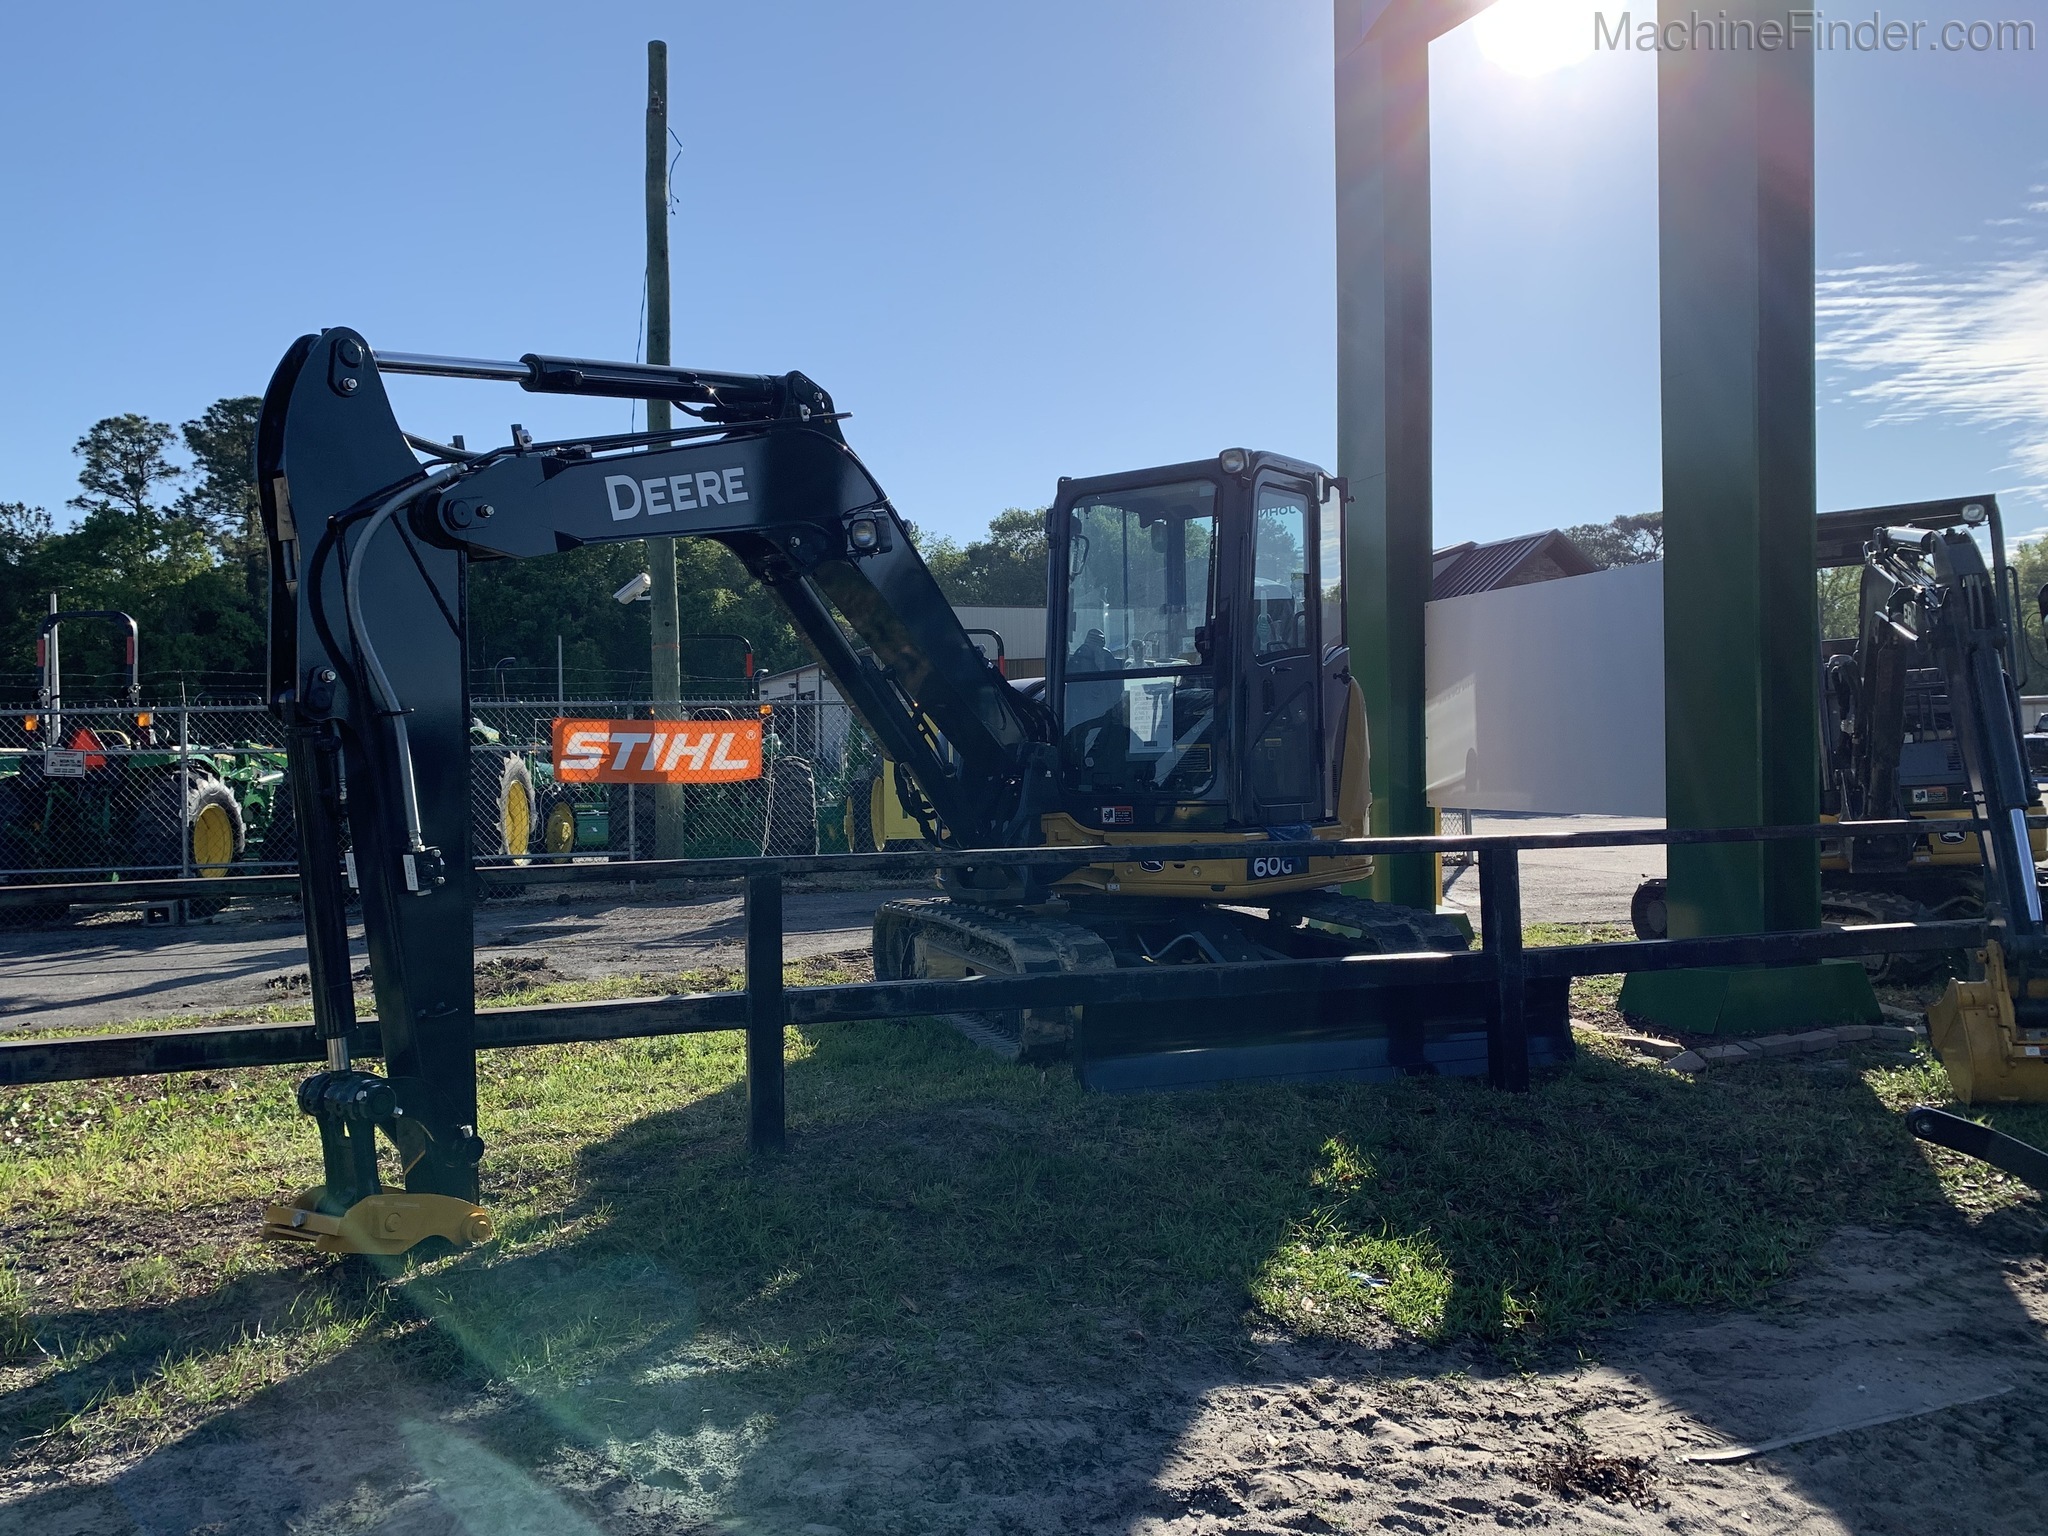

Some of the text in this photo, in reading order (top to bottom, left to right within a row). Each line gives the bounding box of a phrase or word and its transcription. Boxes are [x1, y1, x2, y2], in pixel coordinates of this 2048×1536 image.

[604, 467, 749, 521] DEERE
[559, 732, 750, 770] STIHL
[1253, 857, 1293, 878] 60G
